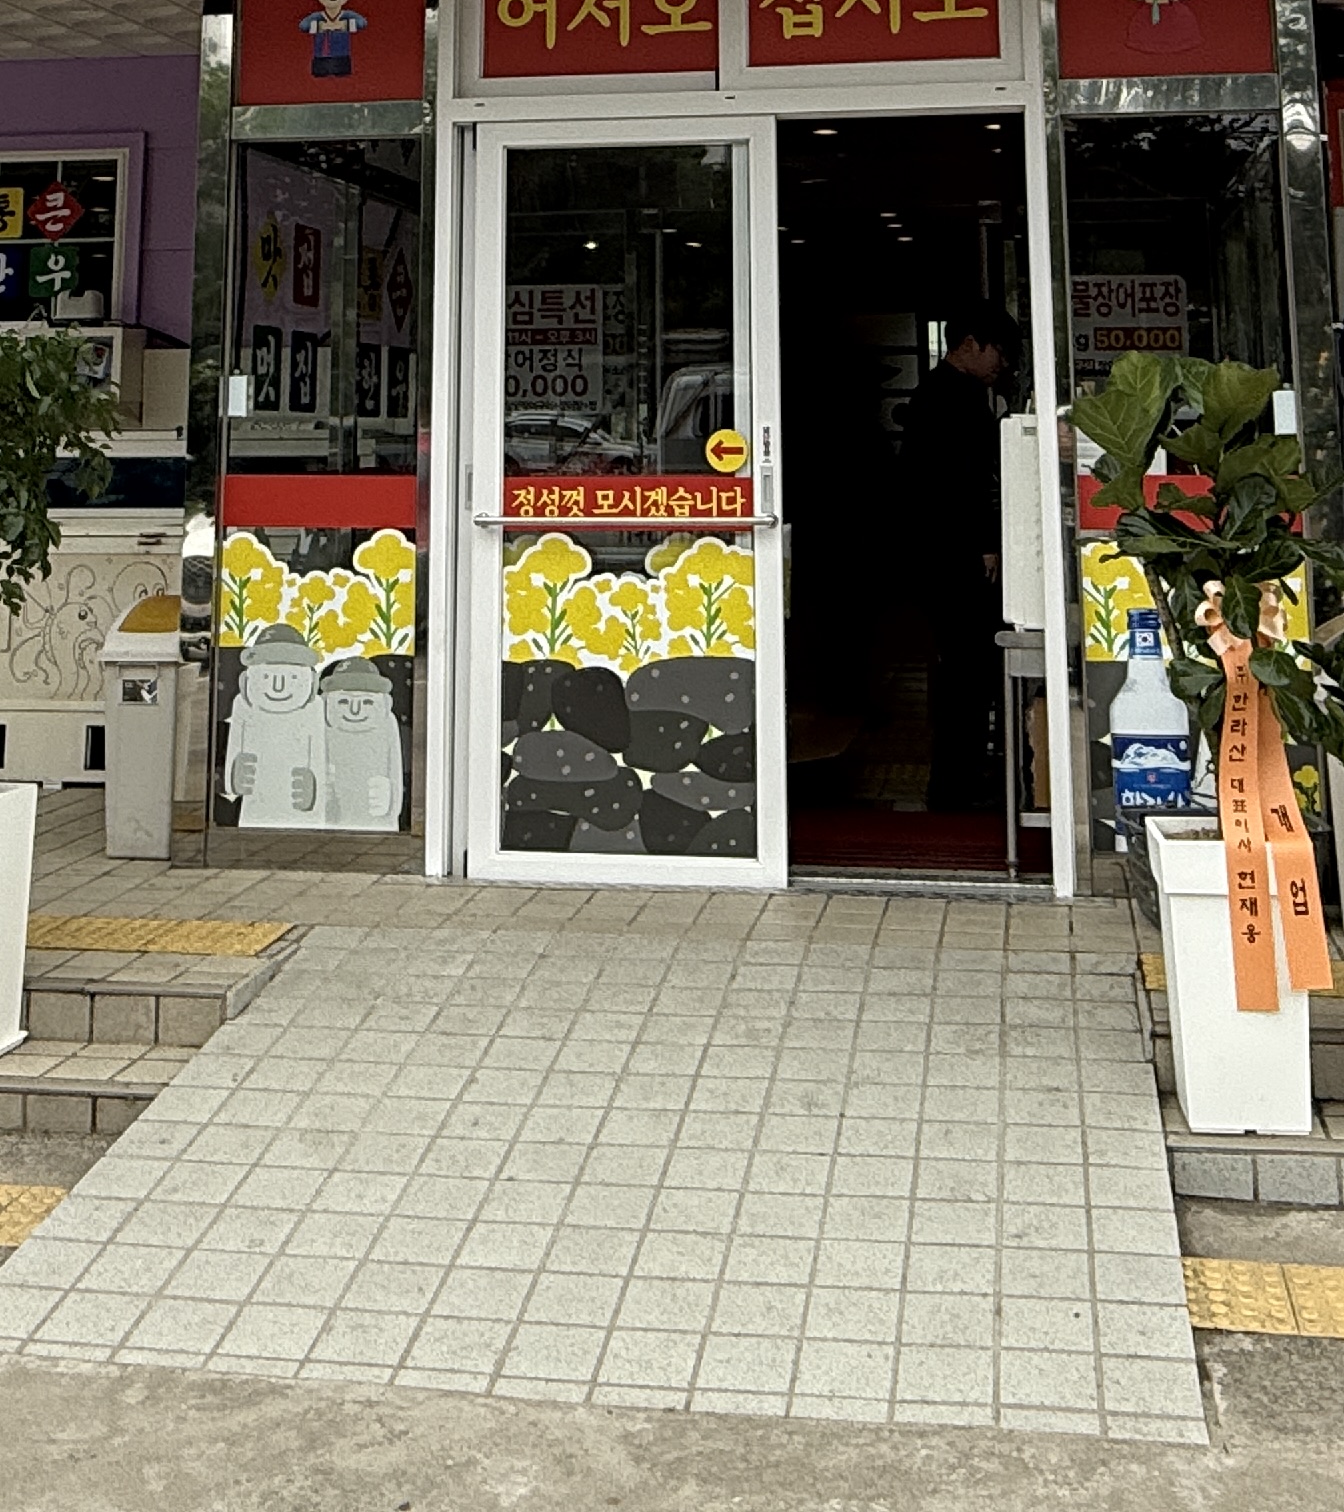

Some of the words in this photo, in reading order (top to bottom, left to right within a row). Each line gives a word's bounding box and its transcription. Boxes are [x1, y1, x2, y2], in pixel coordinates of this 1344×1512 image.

[506, 348, 583, 373] 어정식
[511, 486, 586, 518] 정성껏
[592, 486, 748, 518] 모시겠습니다
